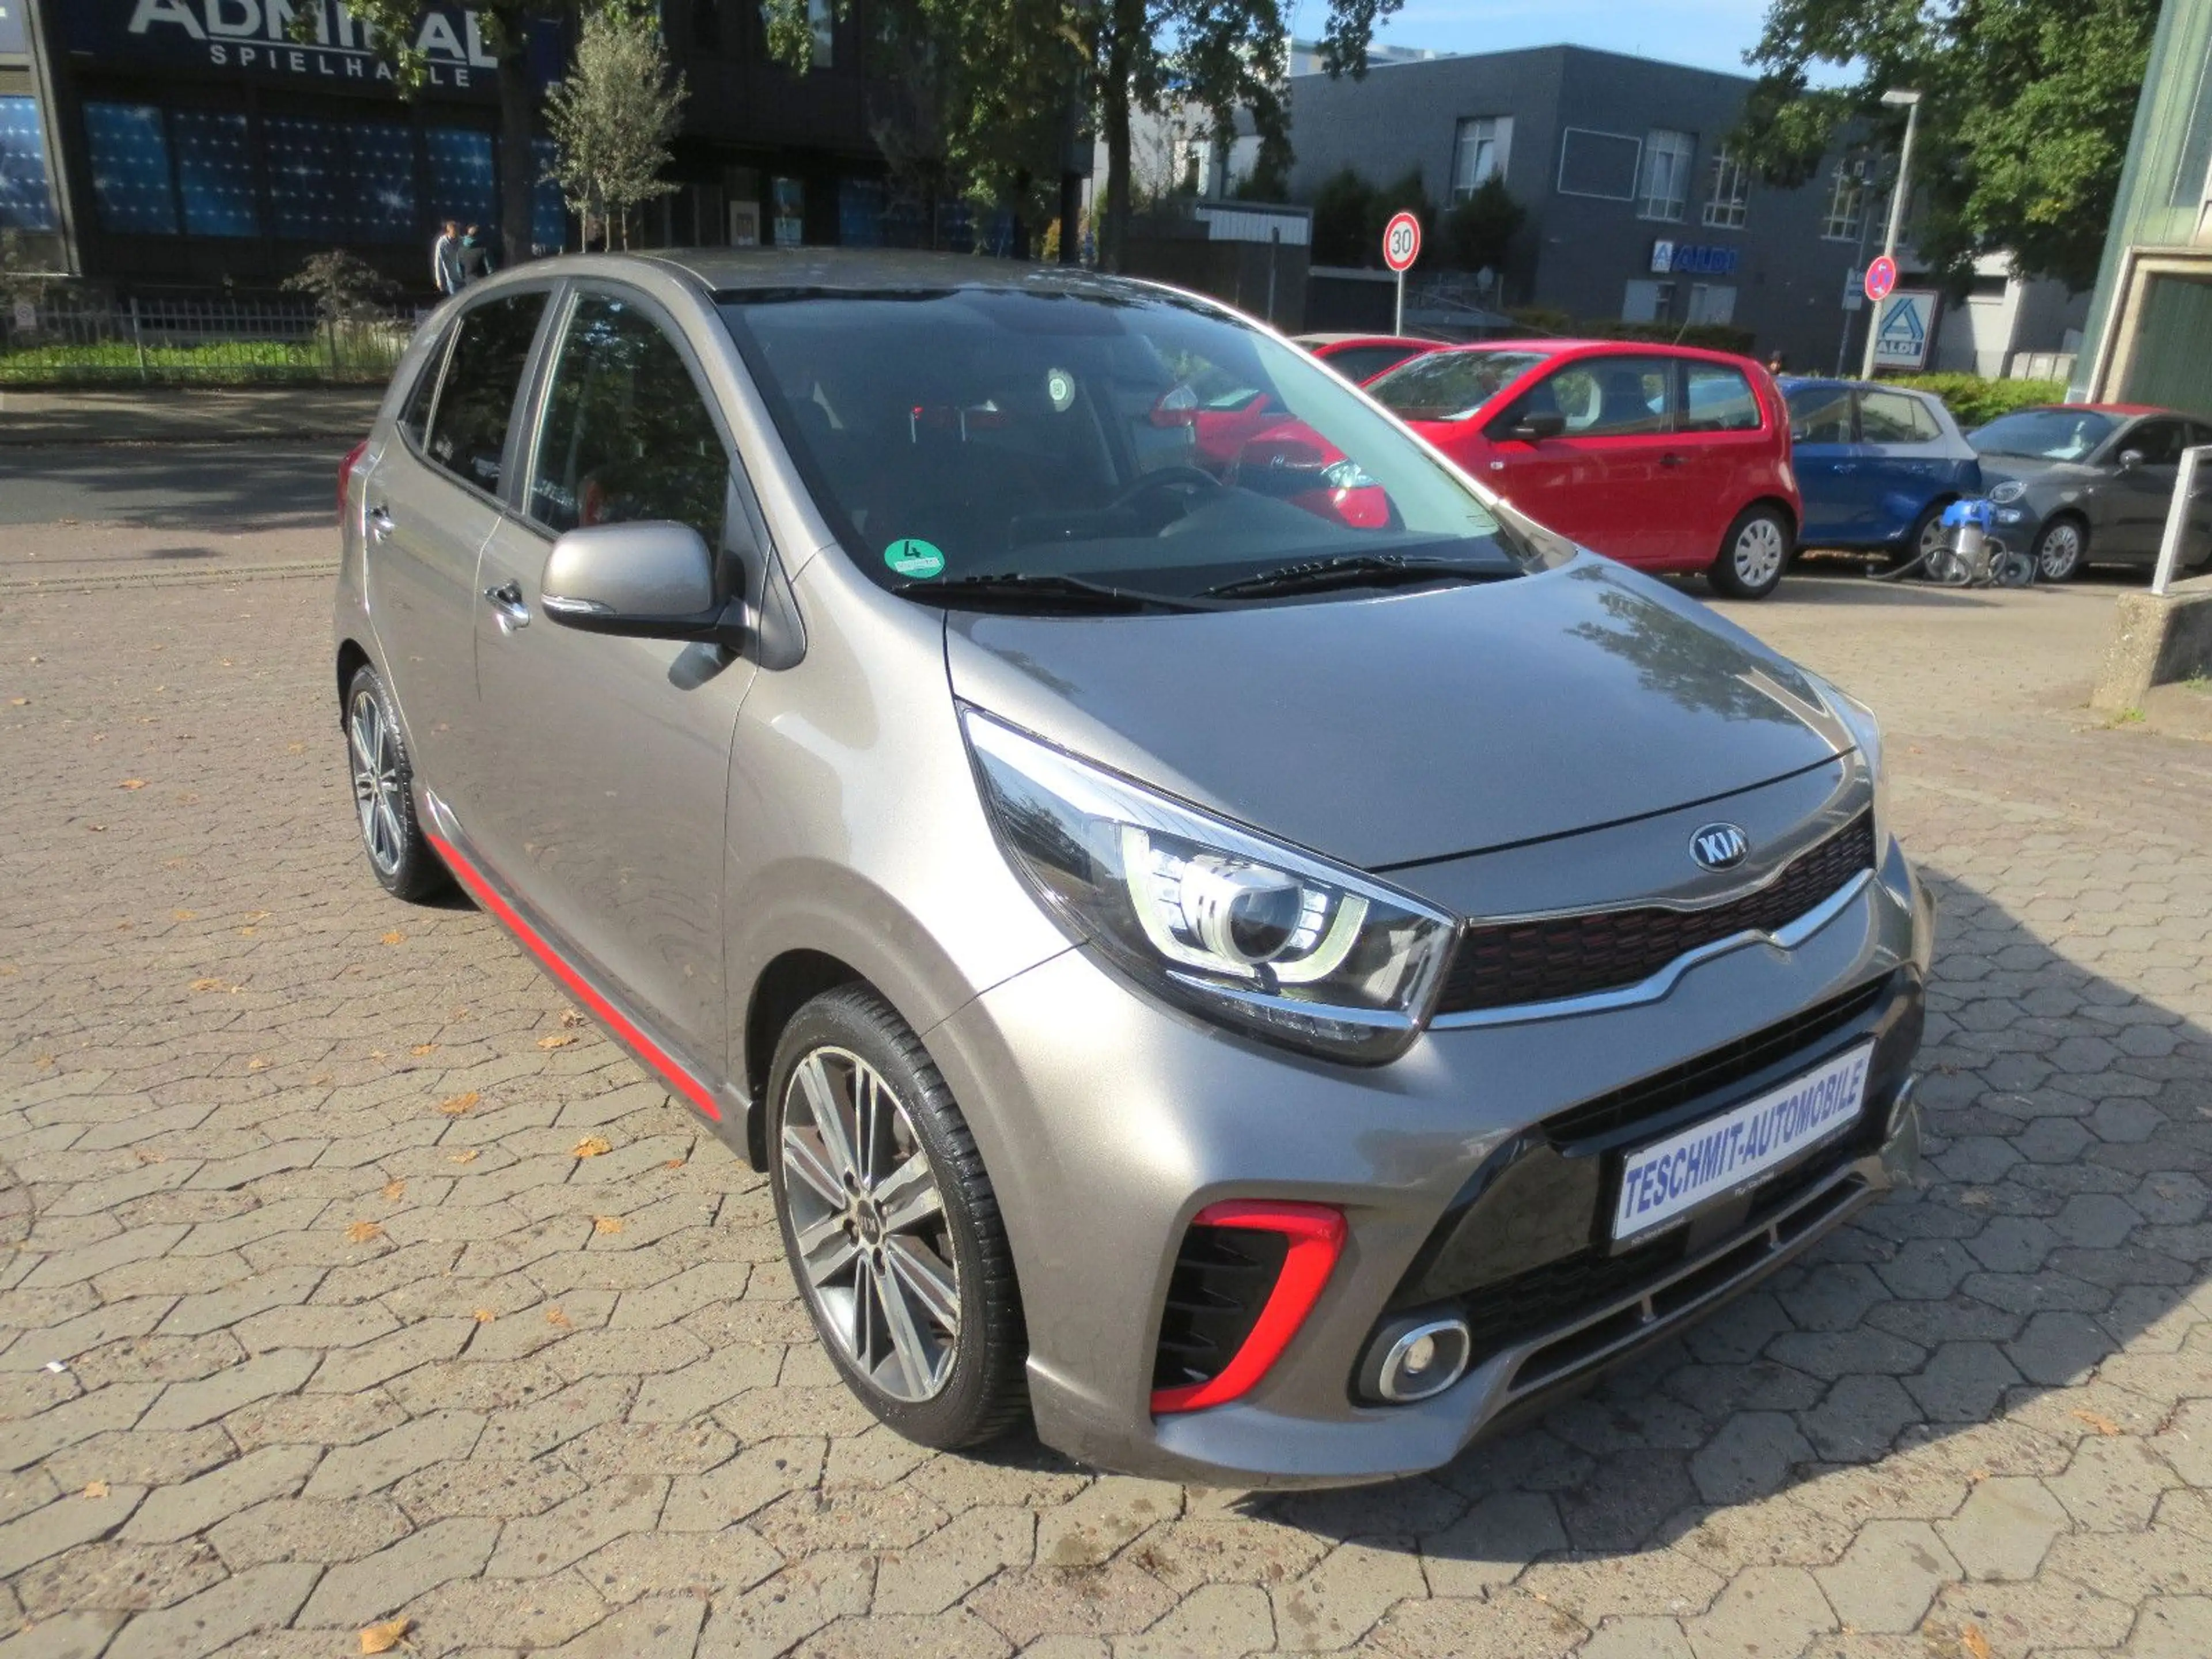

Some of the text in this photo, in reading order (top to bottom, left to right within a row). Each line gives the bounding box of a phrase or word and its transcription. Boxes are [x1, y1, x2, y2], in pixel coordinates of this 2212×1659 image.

[210, 44, 470, 87] SPIELHALE
[1392, 229, 1411, 255] 30
[1877, 340, 1916, 355] ALDI
[904, 541, 921, 558] 4
[1698, 830, 1747, 863] KIA
[1624, 1058, 1863, 1219] TESCHMIT-AUTOMOBILE
